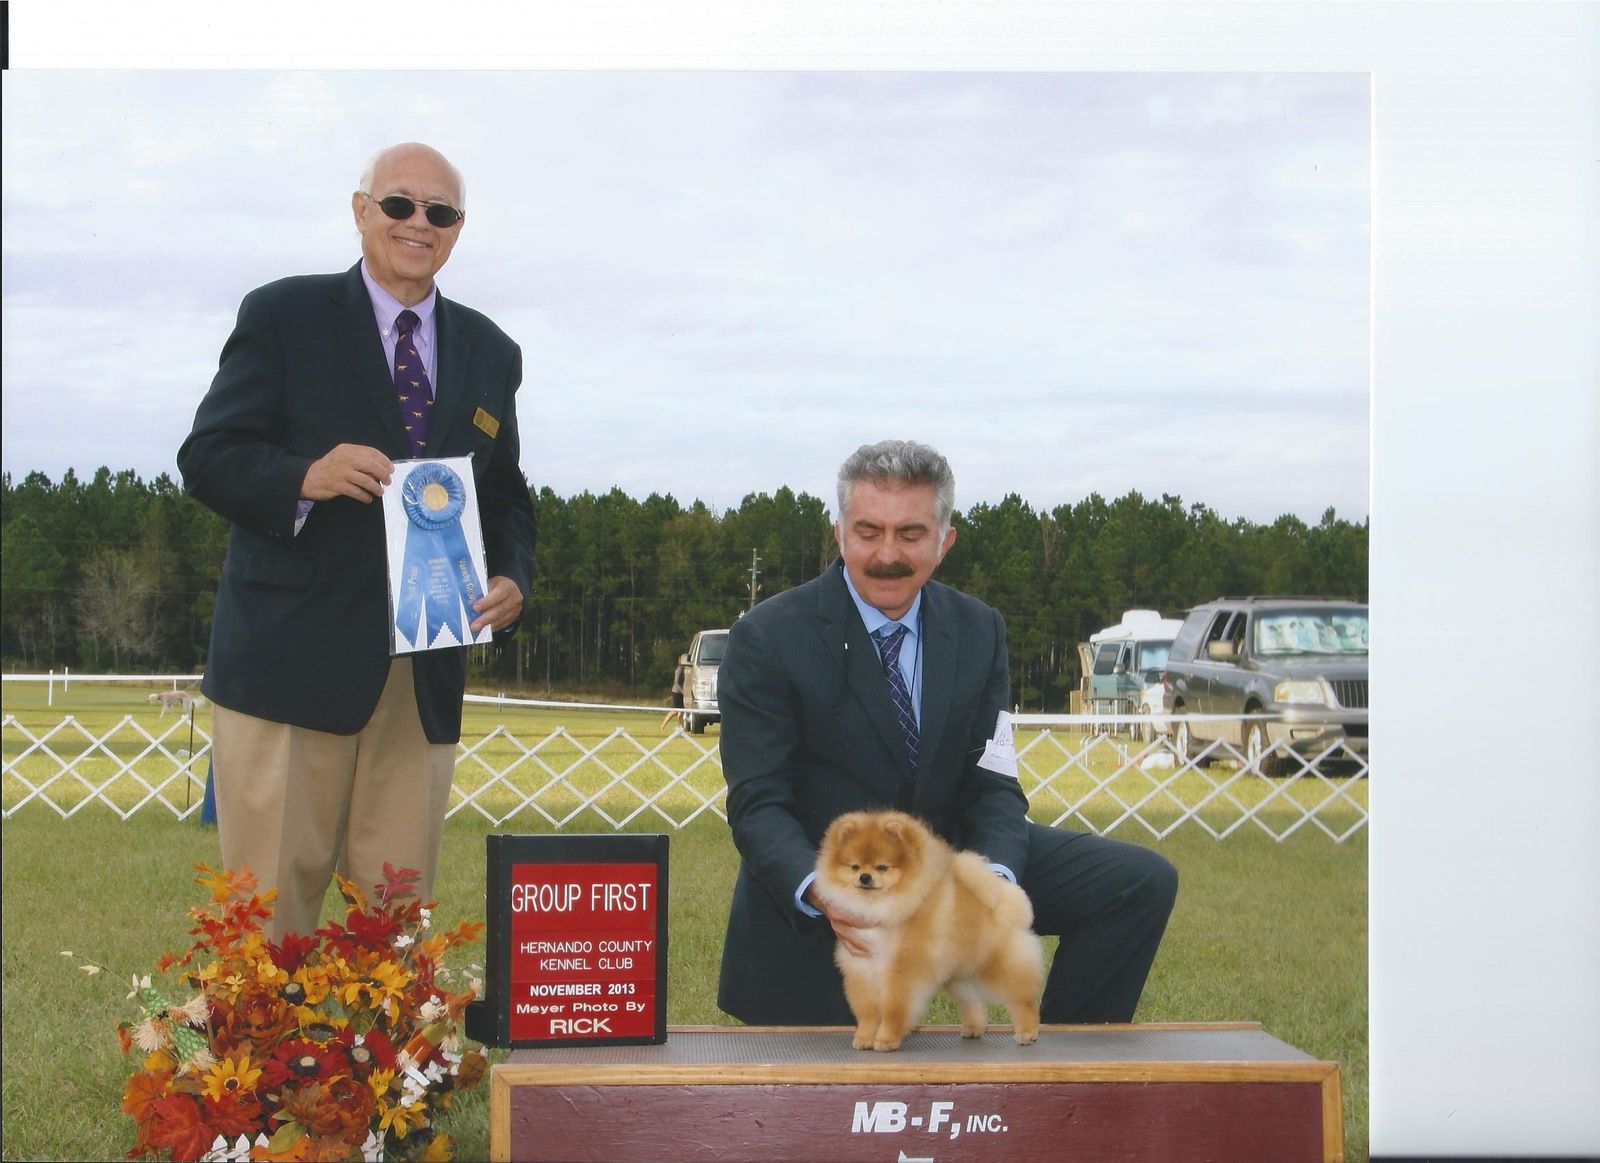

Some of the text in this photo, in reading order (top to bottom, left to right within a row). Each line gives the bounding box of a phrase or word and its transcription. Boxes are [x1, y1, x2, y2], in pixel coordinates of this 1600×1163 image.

[511, 883, 652, 913] GROUP FIRST
[520, 940, 653, 954] HERNANDO COUNTY
[540, 957, 633, 971] KENNEL CLUB
[530, 983, 636, 997] NOVEMBER 2013
[516, 1001, 646, 1015] Meyer Photo By
[550, 1018, 612, 1034] RICK
[966, 1114, 1009, 1133] INC.
